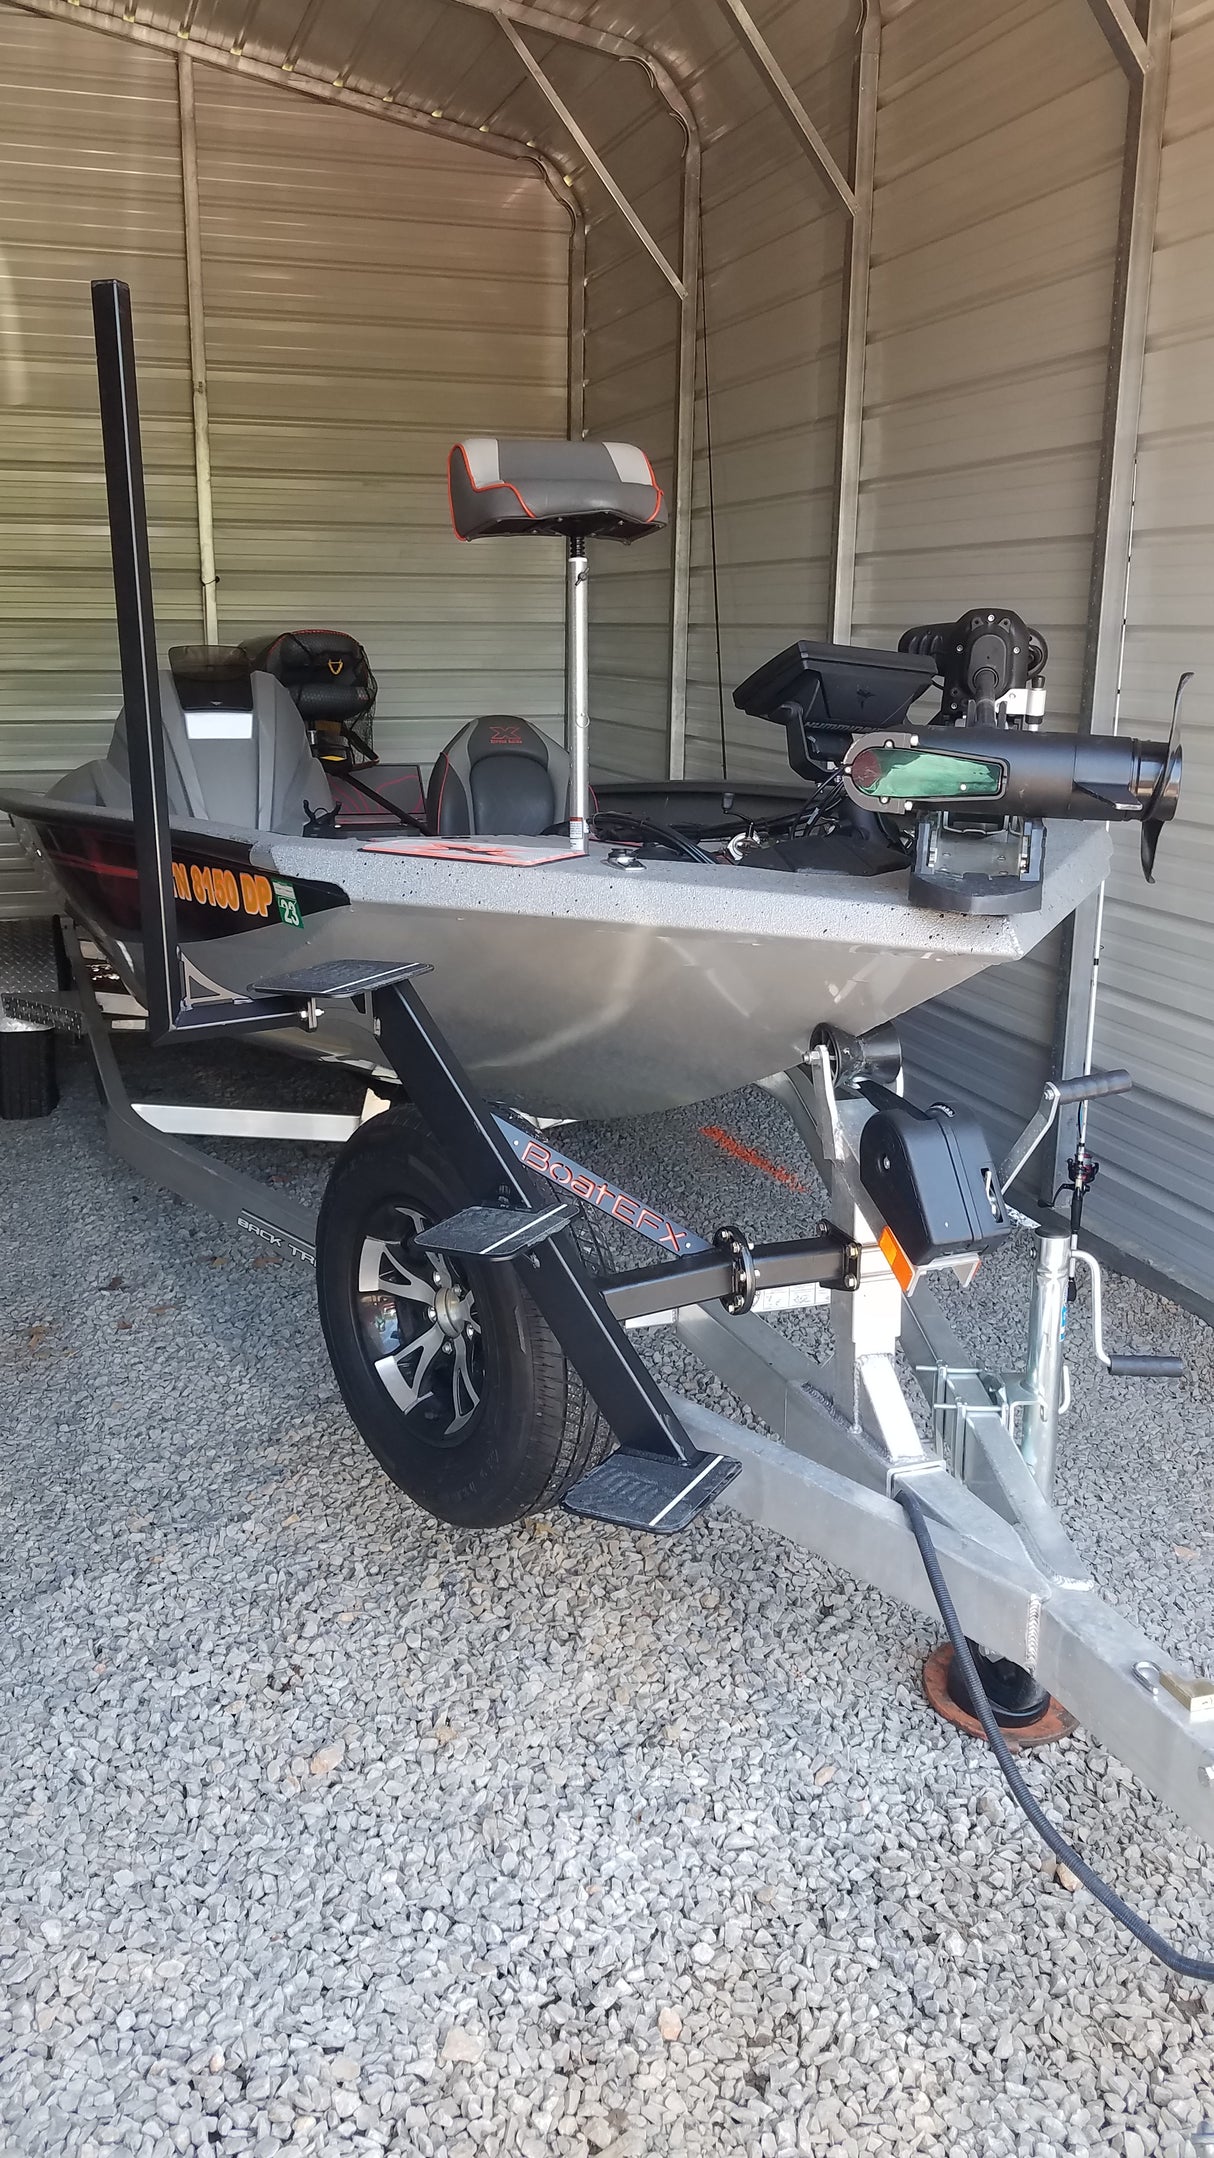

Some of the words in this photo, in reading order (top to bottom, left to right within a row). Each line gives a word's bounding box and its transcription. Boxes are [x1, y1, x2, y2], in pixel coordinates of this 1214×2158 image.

[190, 865, 240, 911] 8150
[240, 873, 272, 917] DP
[280, 898, 300, 926] 23
[237, 1217, 282, 1247] BACK
[288, 1243, 317, 1267] TR
